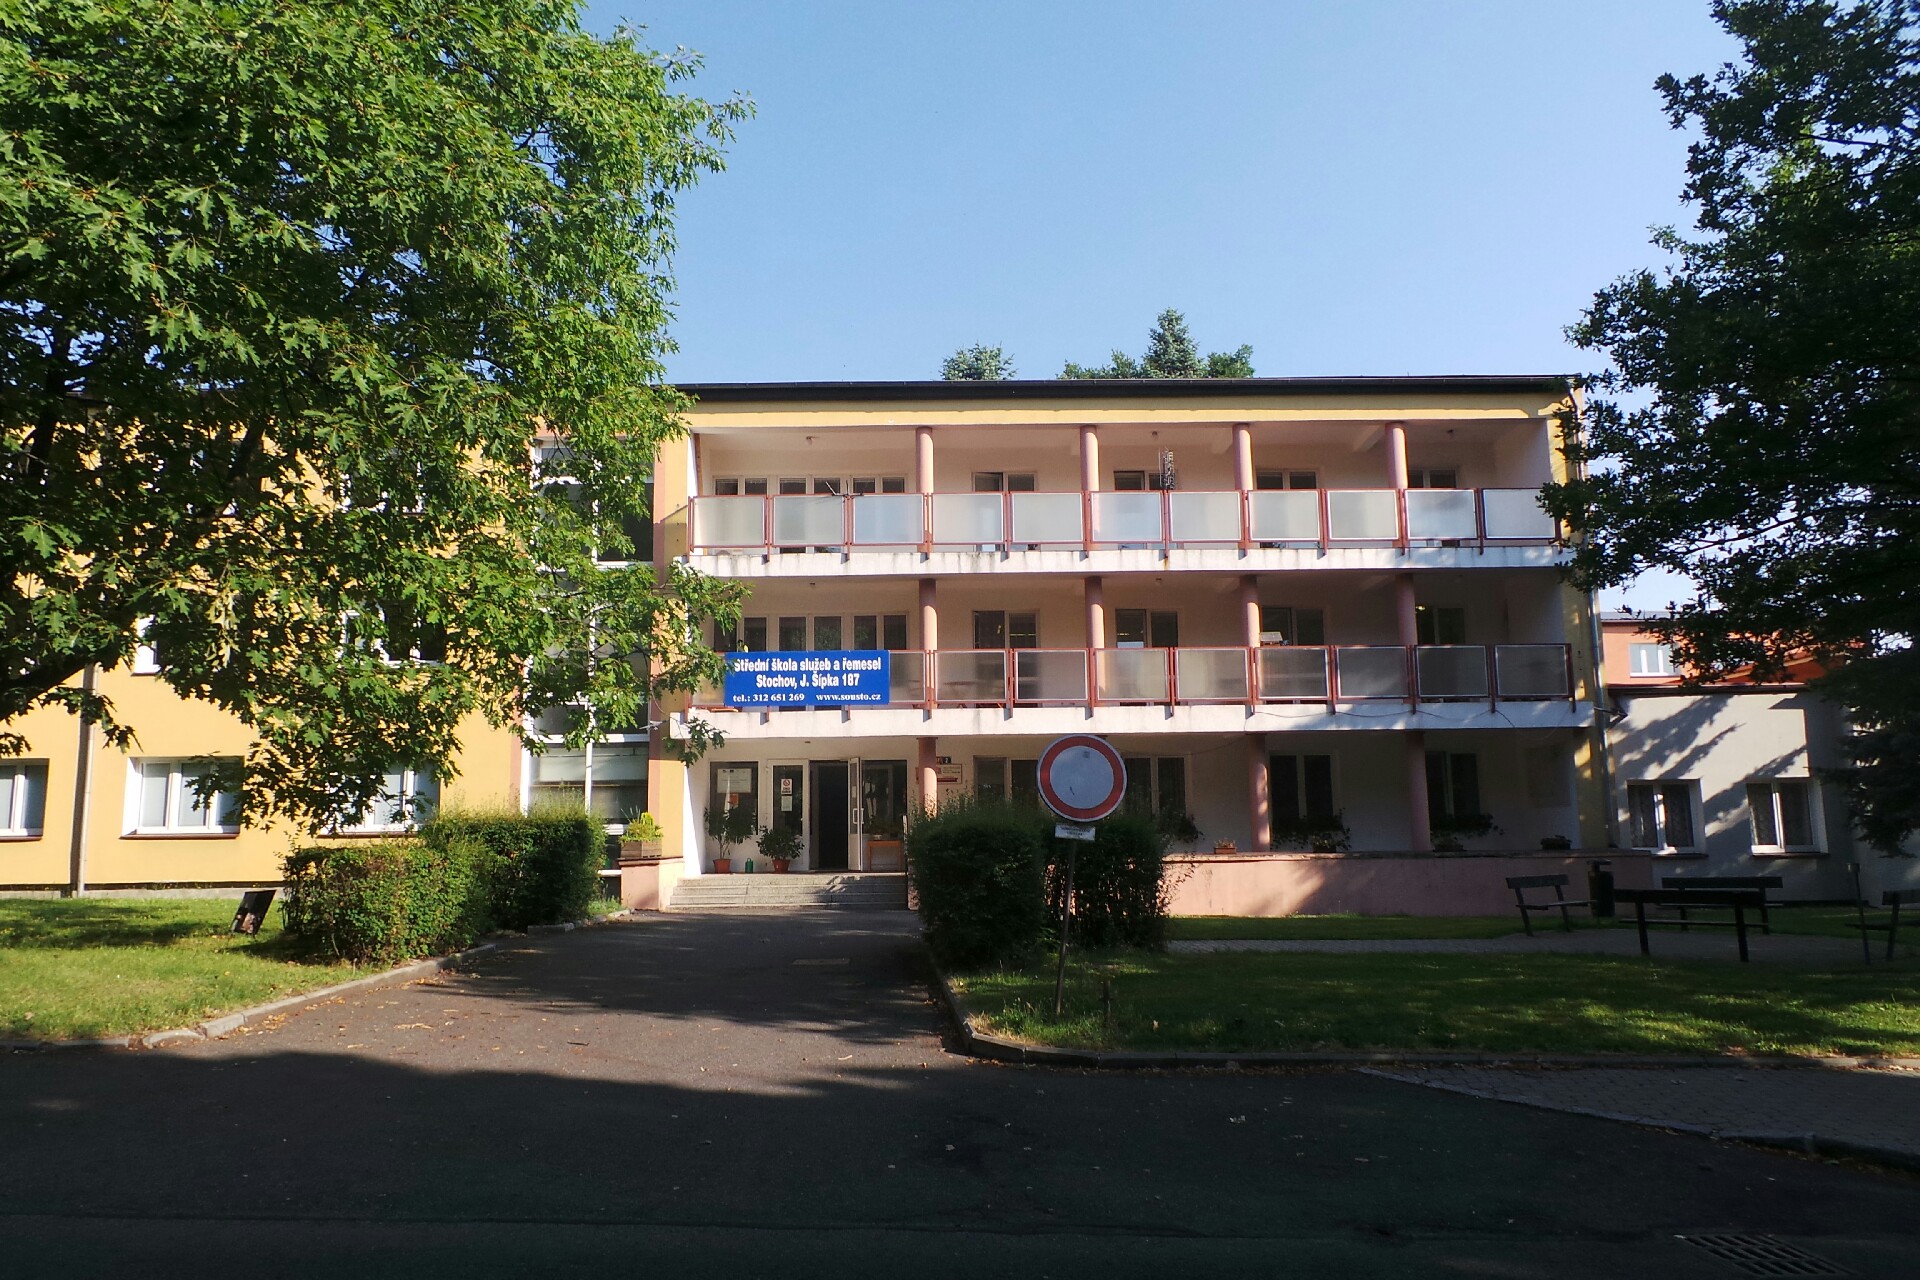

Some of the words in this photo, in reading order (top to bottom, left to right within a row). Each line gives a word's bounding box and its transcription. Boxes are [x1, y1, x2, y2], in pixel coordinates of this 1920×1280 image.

[734, 658, 769, 672] Střední
[771, 658, 798, 672] škola
[800, 658, 831, 671] služeb
[833, 660, 840, 671] a
[842, 657, 881, 671] řemesel
[756, 674, 797, 689] Stochov,
[800, 673, 809, 687] J.
[811, 671, 839, 689] Šípka
[842, 673, 860, 686] 187
[733, 694, 750, 702] tel.:
[752, 693, 768, 702] 312
[771, 693, 786, 702] 651
[789, 693, 805, 701] 269
[816, 693, 881, 701] www.sousto.cz
